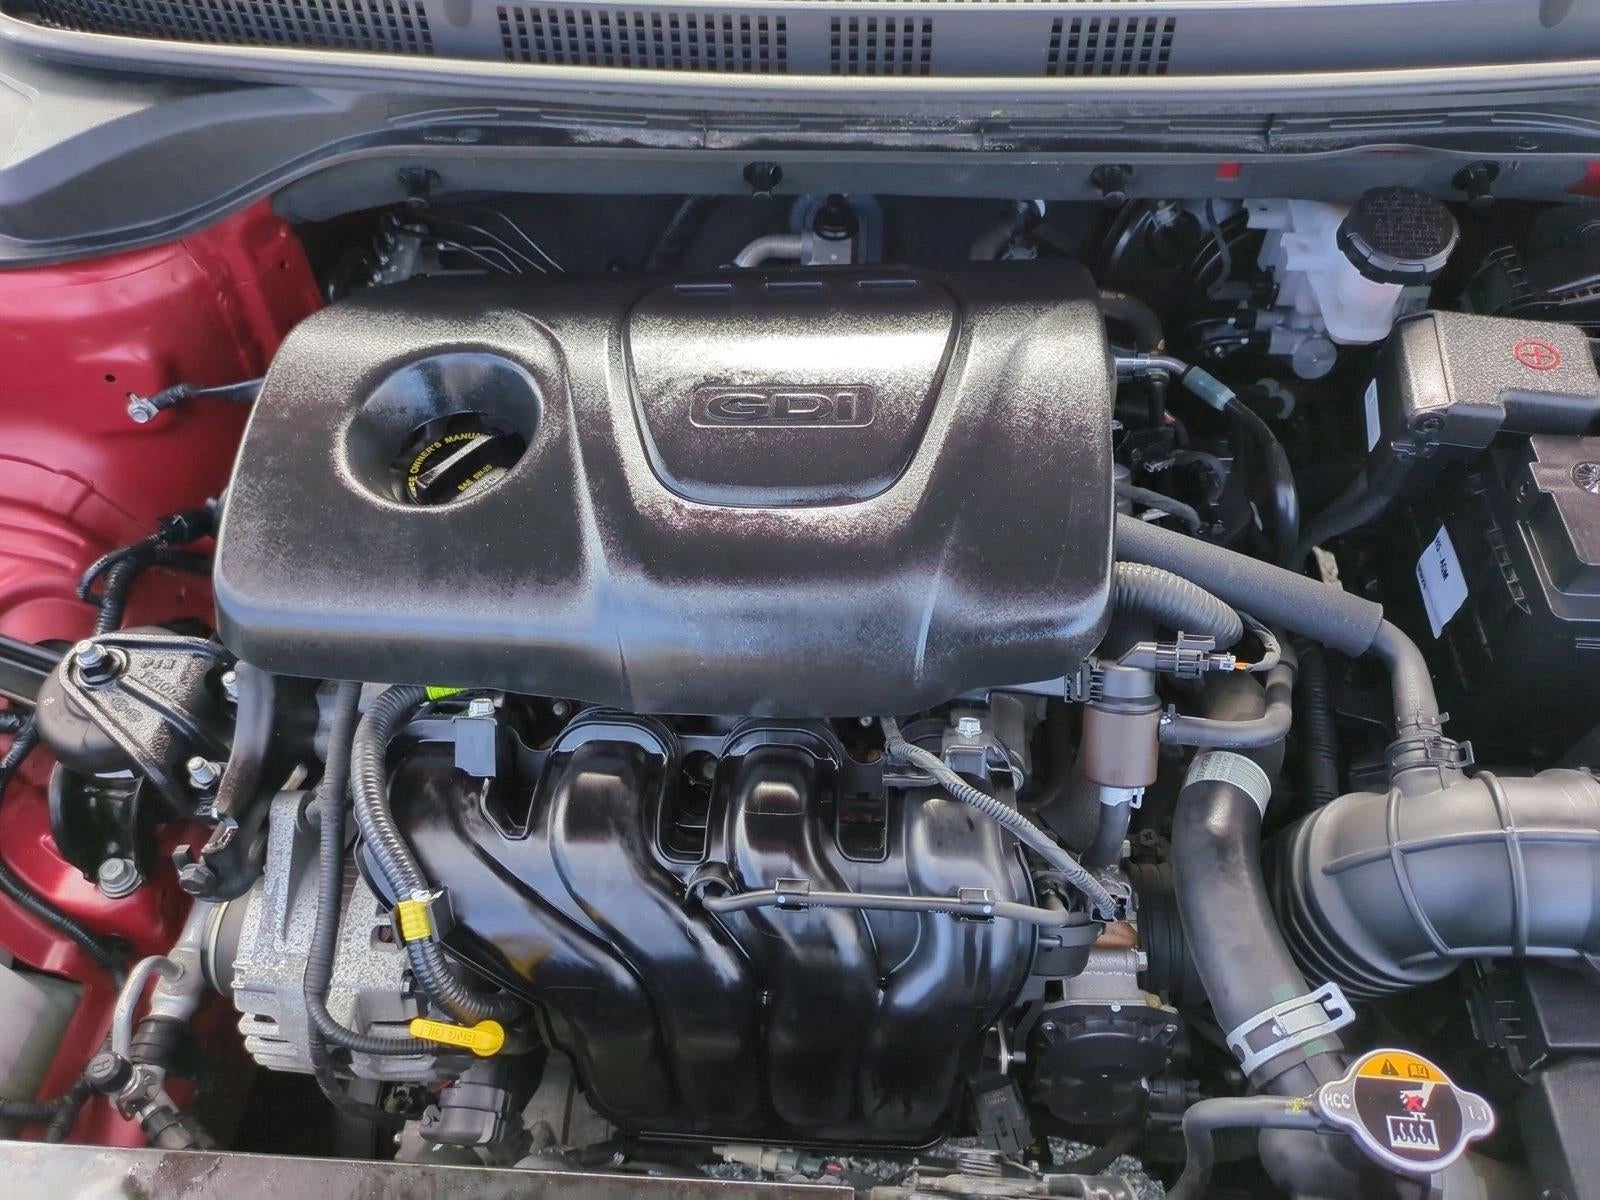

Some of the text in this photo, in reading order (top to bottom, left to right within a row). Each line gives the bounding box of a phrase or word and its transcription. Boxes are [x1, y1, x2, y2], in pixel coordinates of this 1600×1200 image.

[706, 393, 858, 421] GDI
[410, 441, 442, 474] OWNER'S
[445, 432, 482, 443] MANUA
[457, 478, 473, 491] SAE
[423, 1022, 475, 1043] ENG OIL
[1324, 1093, 1350, 1109] HCC
[1468, 1105, 1488, 1120] 1.1
